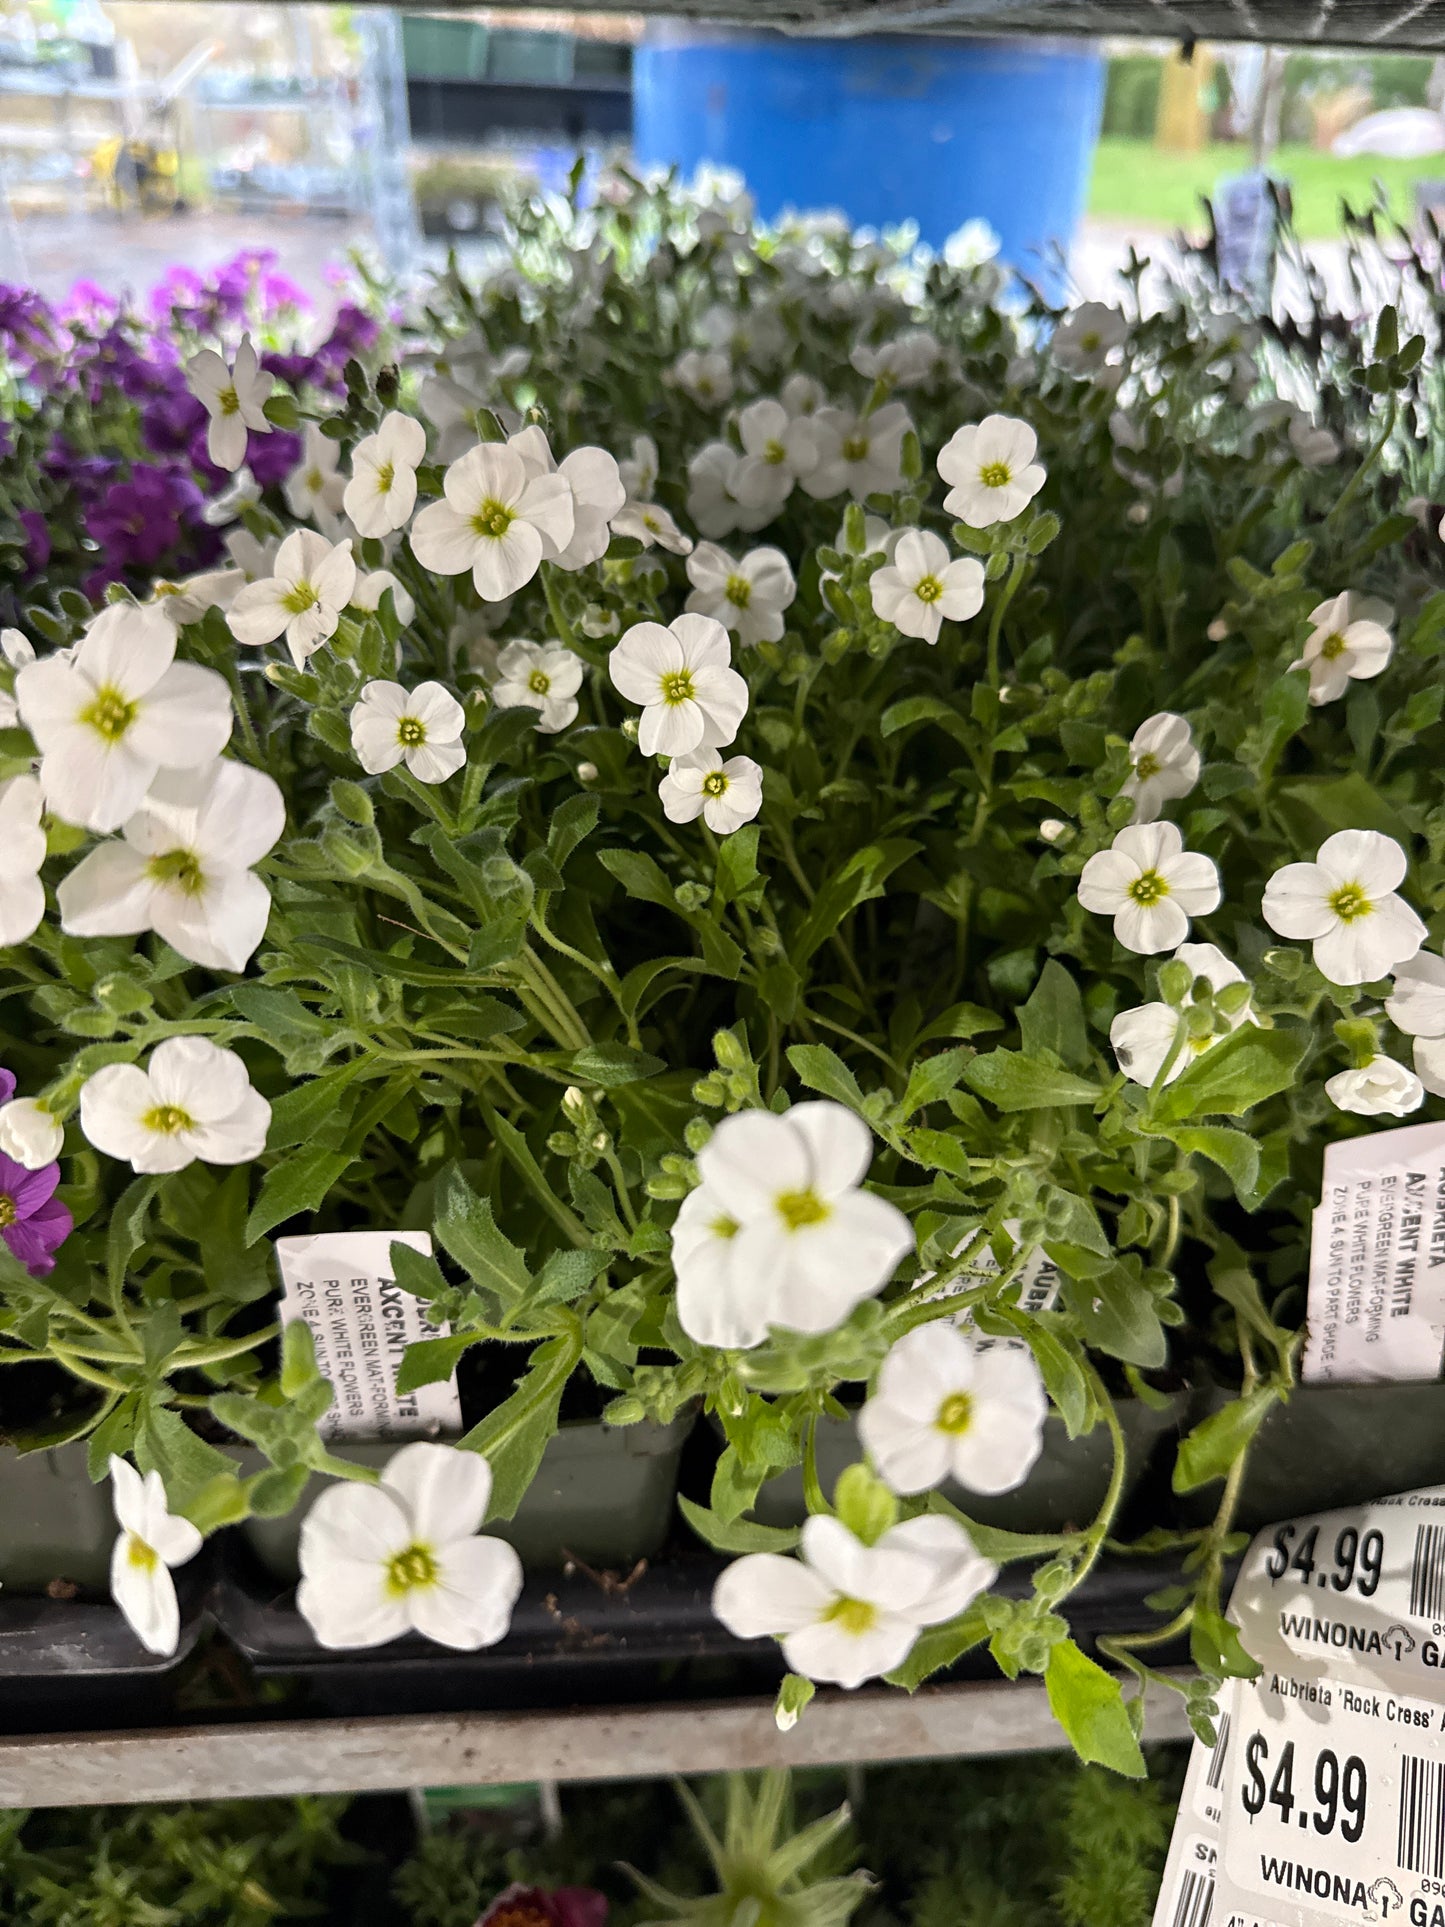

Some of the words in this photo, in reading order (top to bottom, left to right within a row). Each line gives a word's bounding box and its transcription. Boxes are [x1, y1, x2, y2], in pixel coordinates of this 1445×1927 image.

[1329, 1240, 1344, 1267] SUN
[1350, 1221, 1368, 1263] WHITE
[1327, 1268, 1342, 1286] TO
[1345, 1265, 1364, 1324] FLOWERS
[1366, 1260, 1388, 1343] MAT-FORMING
[1390, 1257, 1416, 1318] WHITE
[351, 1278, 379, 1357] EVERGREEN
[1324, 1289, 1340, 1319] PART
[331, 1318, 353, 1358] WHITE
[1321, 1322, 1337, 1361] SHADE
[339, 1360, 364, 1417] FLOWERS
[1265, 1524, 1384, 1597] $4.99
[1281, 1612, 1382, 1656] WINONA
[1270, 1673, 1332, 1706] Aubrieta
[1338, 1689, 1380, 1717] 'Rock
[1241, 1729, 1367, 1843] $4.99
[1261, 1854, 1368, 1910] WINONA
